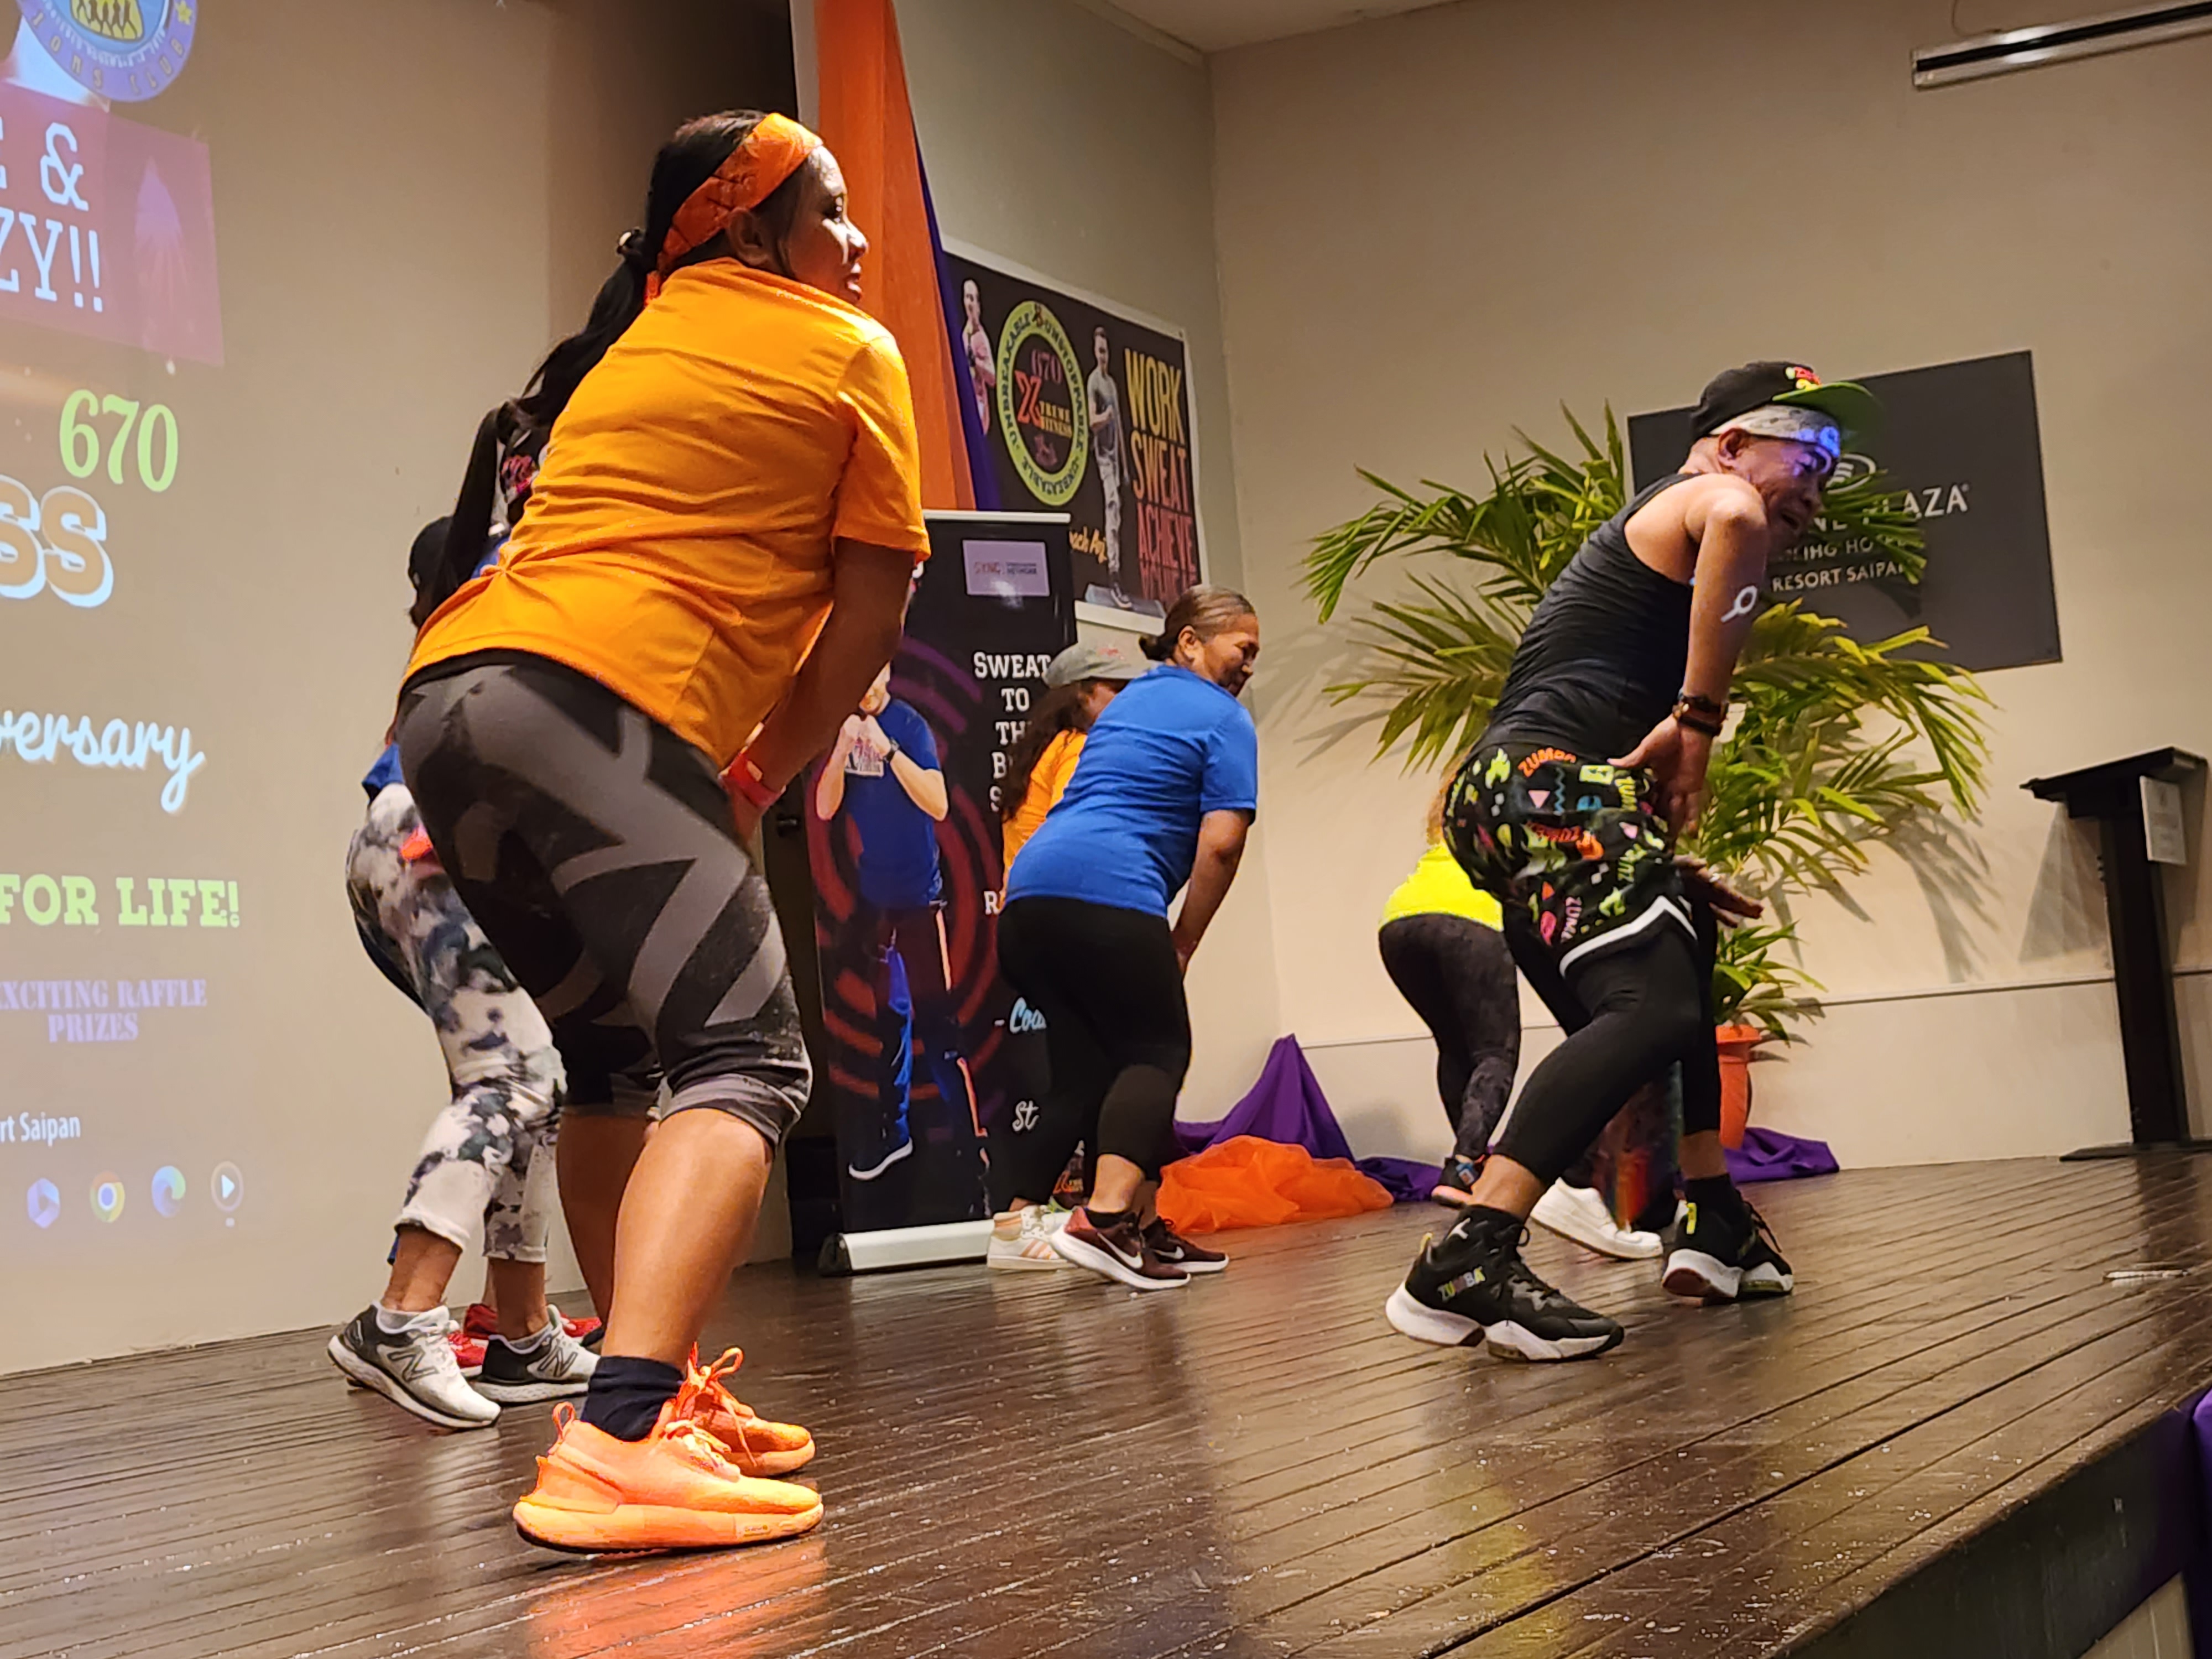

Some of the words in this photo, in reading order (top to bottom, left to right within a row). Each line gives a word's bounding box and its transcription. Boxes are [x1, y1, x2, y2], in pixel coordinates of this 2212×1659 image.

[129, 38, 185, 96] CLUB
[40, 122, 89, 211] &
[1125, 348, 1185, 446] WORK
[59, 389, 179, 493] 670
[1131, 430, 1189, 513] SWEAT
[1137, 501, 1197, 573] ACHIEVE
[1804, 544, 1837, 561] IHG
[1772, 567, 1841, 592] RESORT
[973, 651, 1051, 679] SWEAT
[1001, 687, 1030, 712] TO
[995, 721, 1032, 746] TH
[116, 877, 241, 928] LIFE!
[0, 979, 109, 1010] XCITING
[117, 979, 208, 1009] RAFFLE
[47, 1013, 139, 1043] PRIZES
[19, 1110, 81, 1148] Saipan
